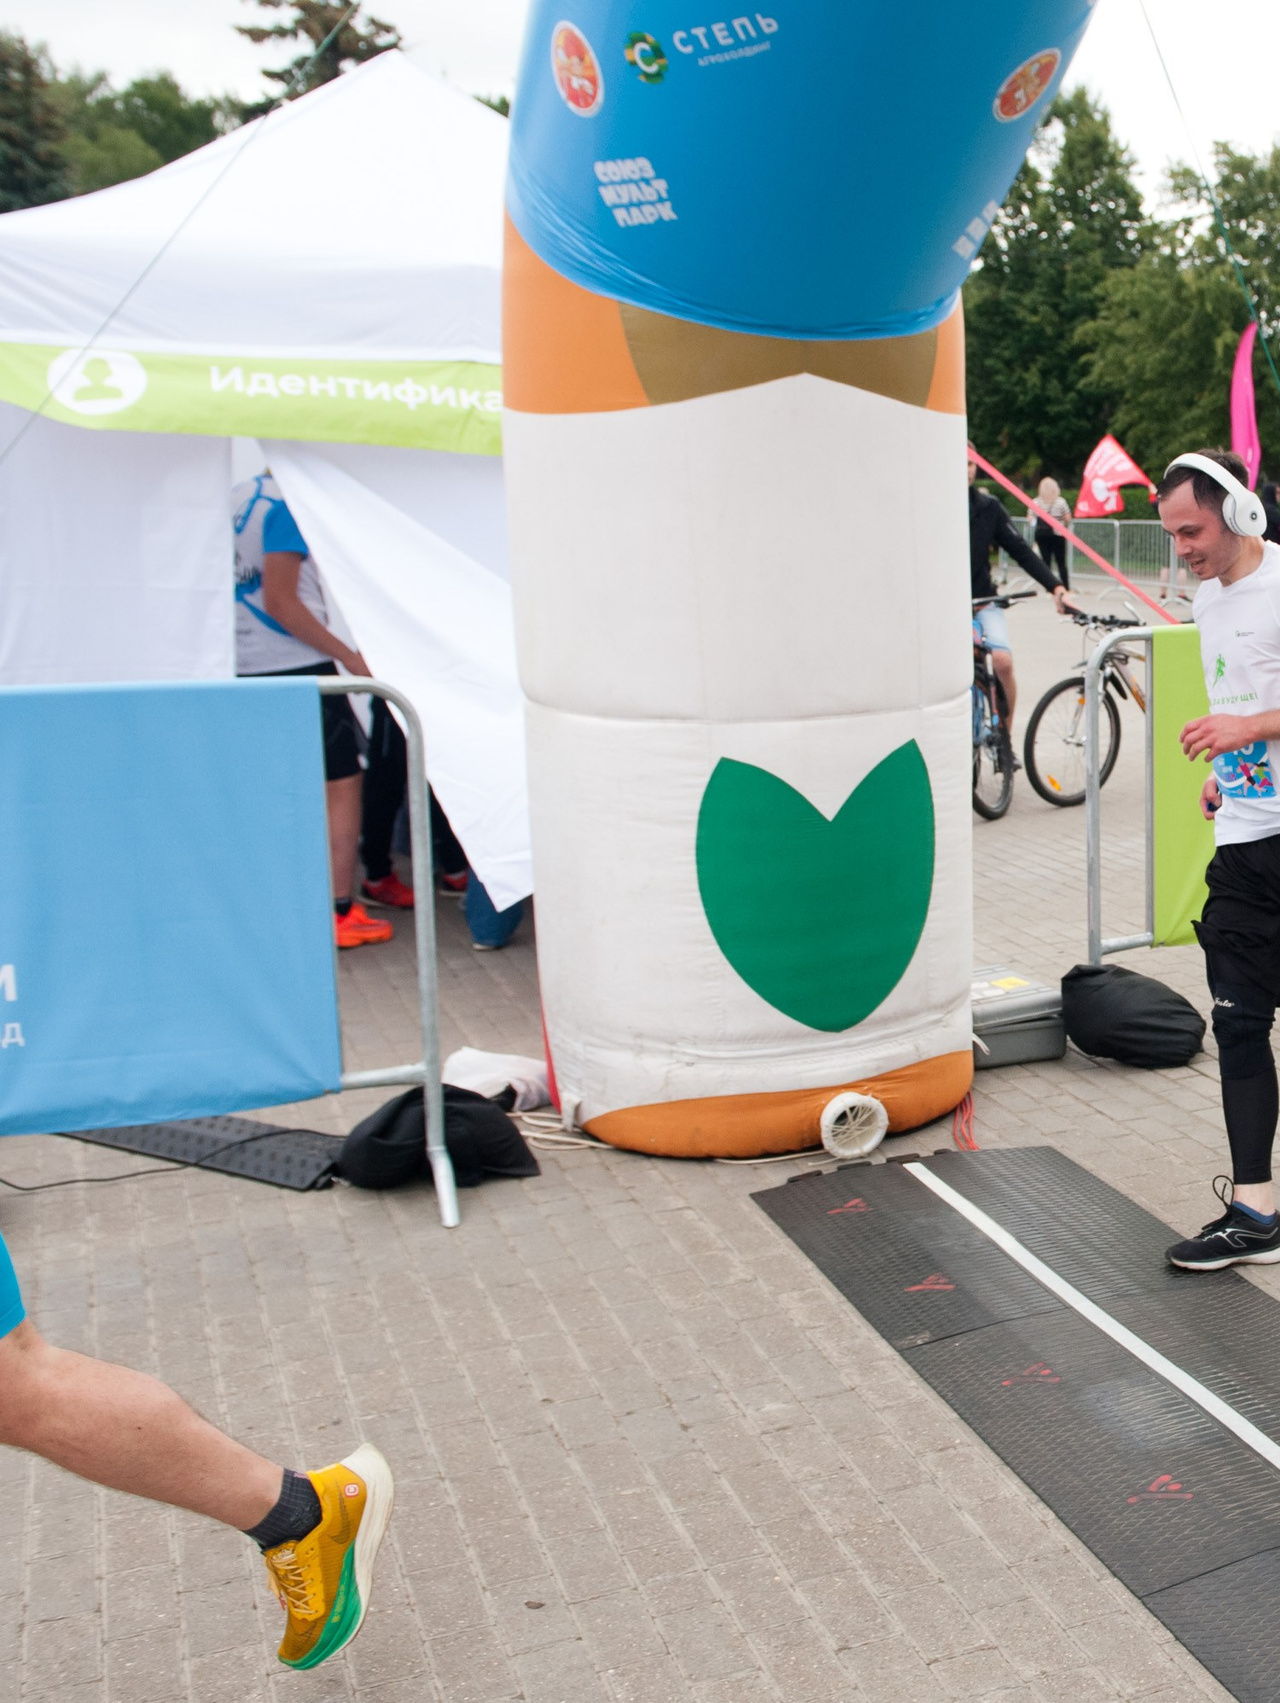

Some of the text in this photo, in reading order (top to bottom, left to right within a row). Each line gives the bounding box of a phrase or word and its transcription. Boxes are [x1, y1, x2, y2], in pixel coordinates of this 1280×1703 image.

[672, 12, 779, 54] СТЕПЬ
[593, 156, 656, 183] СОЮЗ
[597, 178, 669, 207] МУЛЬТ
[612, 201, 679, 228] ПАРК
